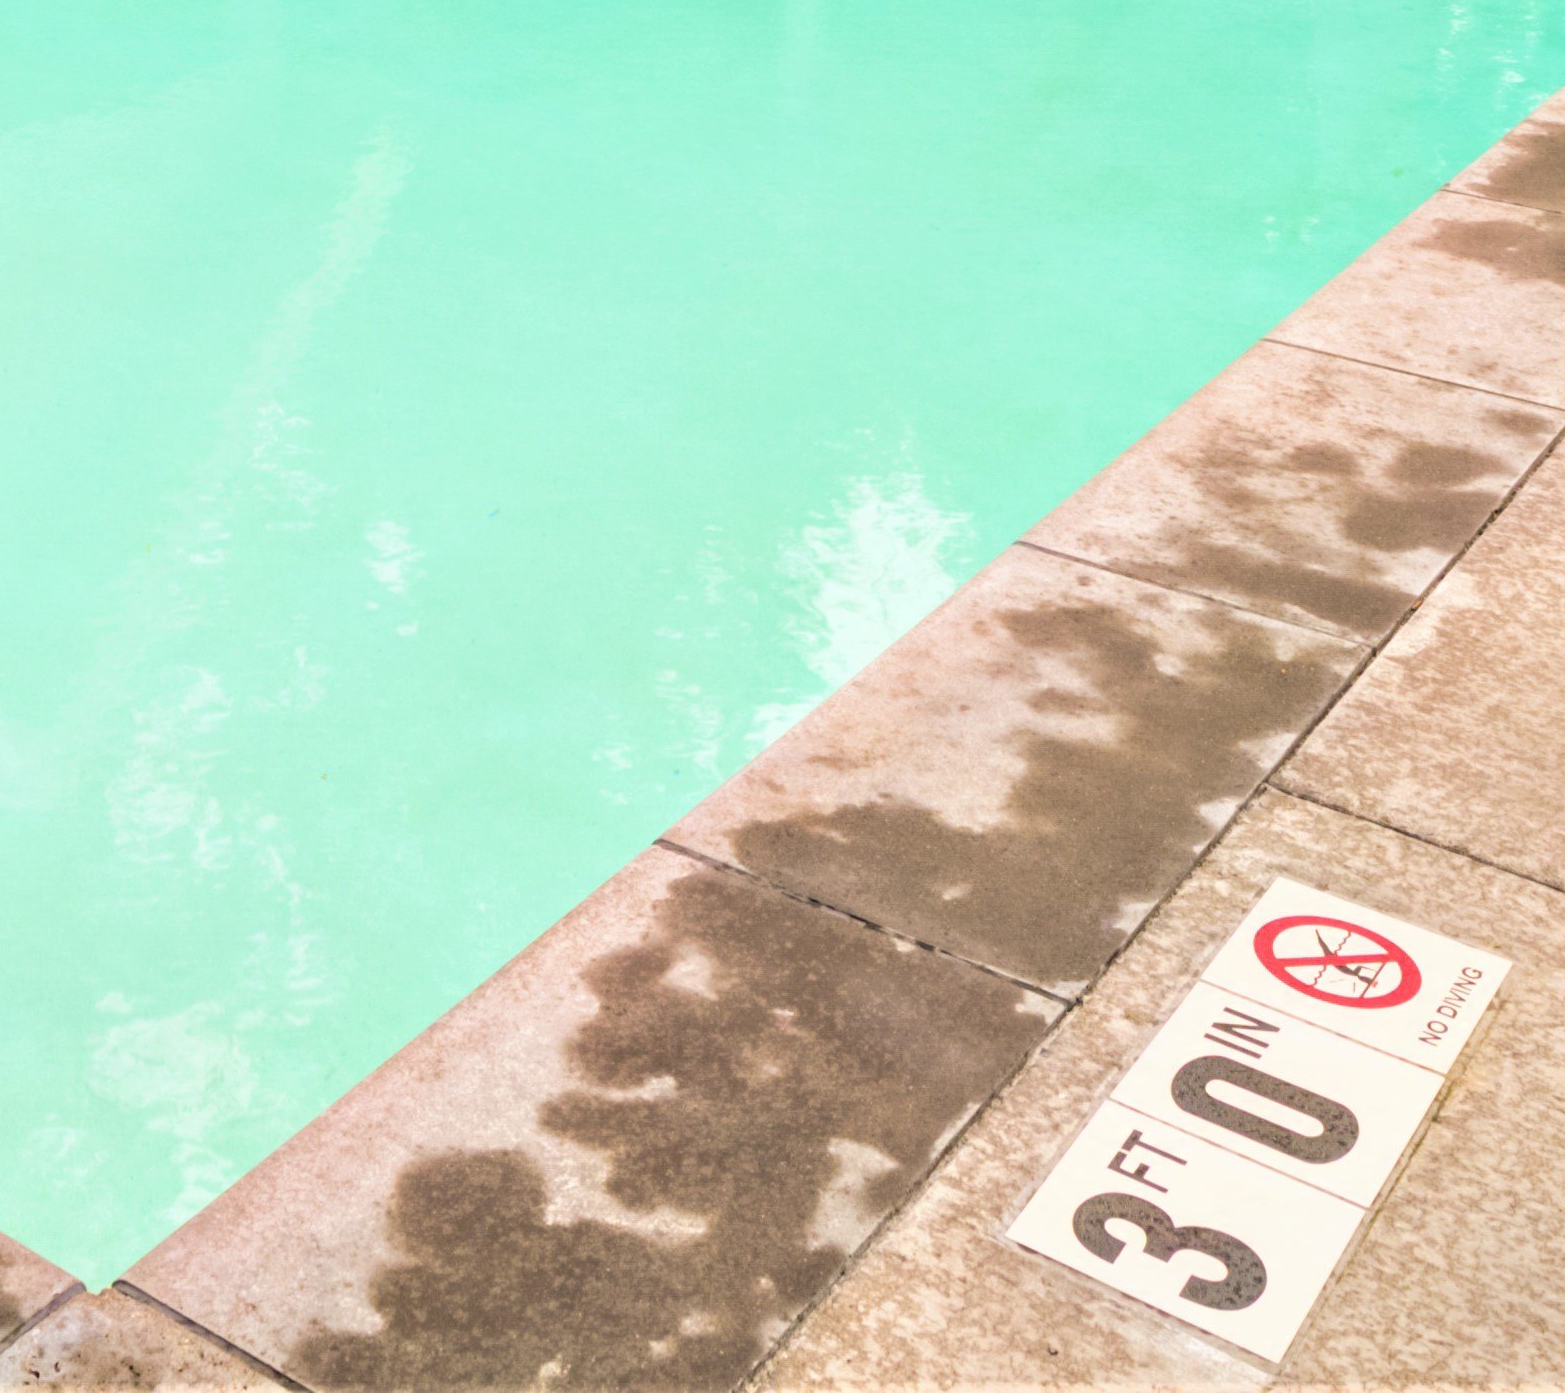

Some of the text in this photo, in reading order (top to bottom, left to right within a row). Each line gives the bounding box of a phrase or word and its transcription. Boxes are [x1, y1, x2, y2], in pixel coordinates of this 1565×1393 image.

[1418, 966, 1484, 1047] NO DIVING
[1072, 1006, 1359, 1311] 3 FT 0 IN
